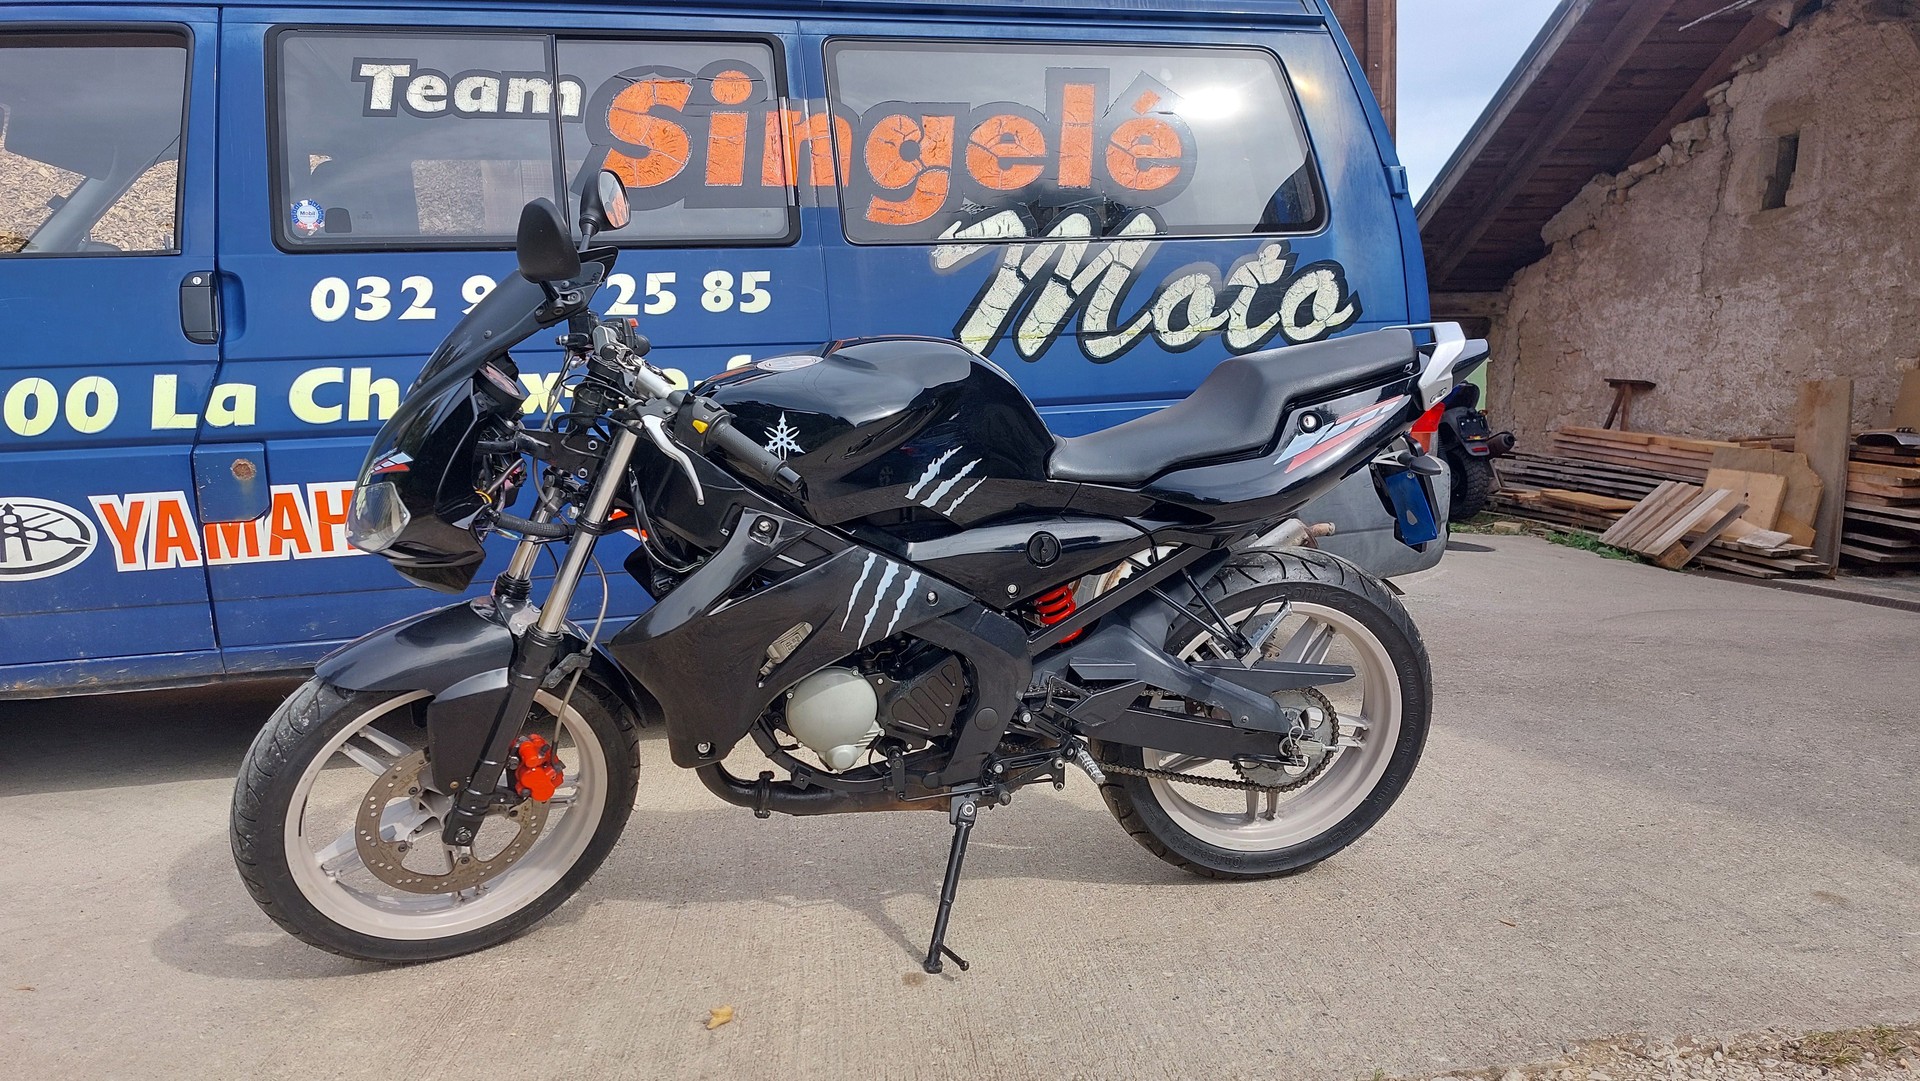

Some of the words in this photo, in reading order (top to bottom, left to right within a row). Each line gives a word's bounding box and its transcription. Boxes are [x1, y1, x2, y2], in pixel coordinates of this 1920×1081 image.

[360, 63, 581, 117] Team
[602, 69, 1183, 225] Singelé
[311, 275, 437, 322] 032
[604, 271, 677, 316] 25
[701, 270, 772, 314] 85
[932, 208, 1355, 358] Moto
[4, 376, 118, 436] 00
[152, 374, 257, 430] La
[99, 489, 357, 565] YAMAH
